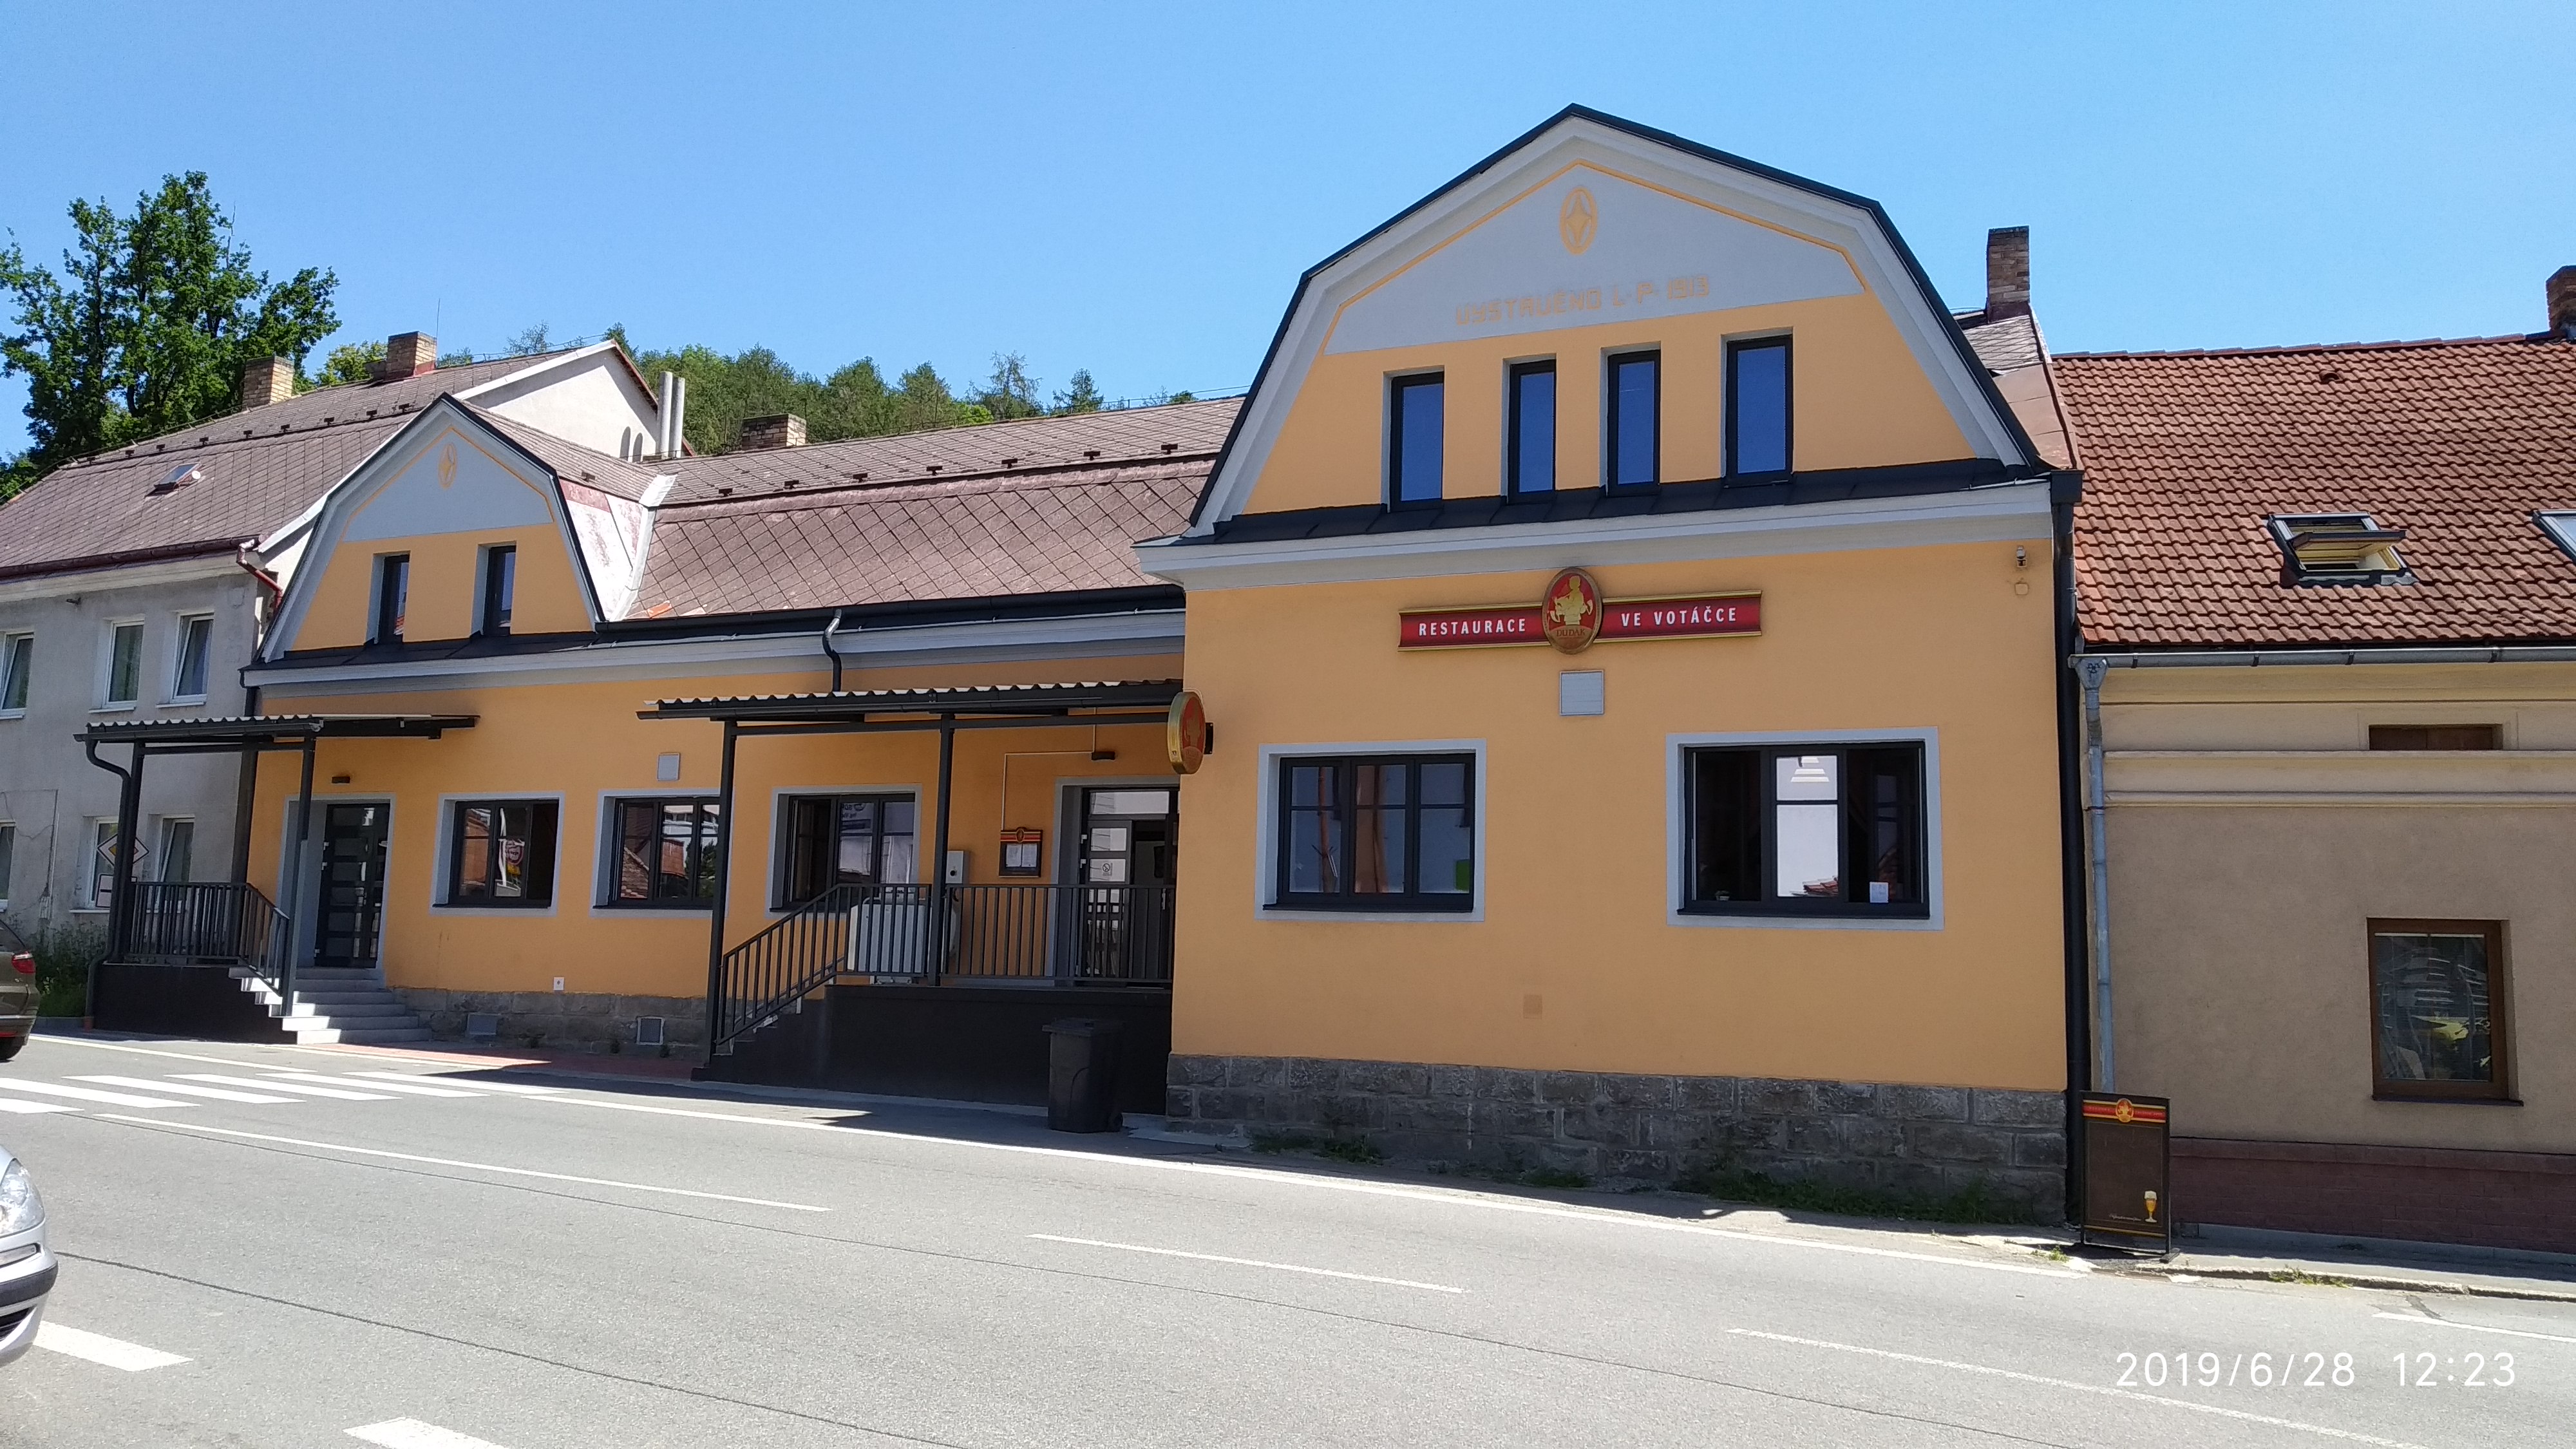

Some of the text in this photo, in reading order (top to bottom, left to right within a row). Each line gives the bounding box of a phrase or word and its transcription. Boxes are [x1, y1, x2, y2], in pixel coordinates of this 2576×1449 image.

[1621, 605, 1736, 627] VE VOTÁČCE
[1419, 618, 1526, 636] RESTAURACE
